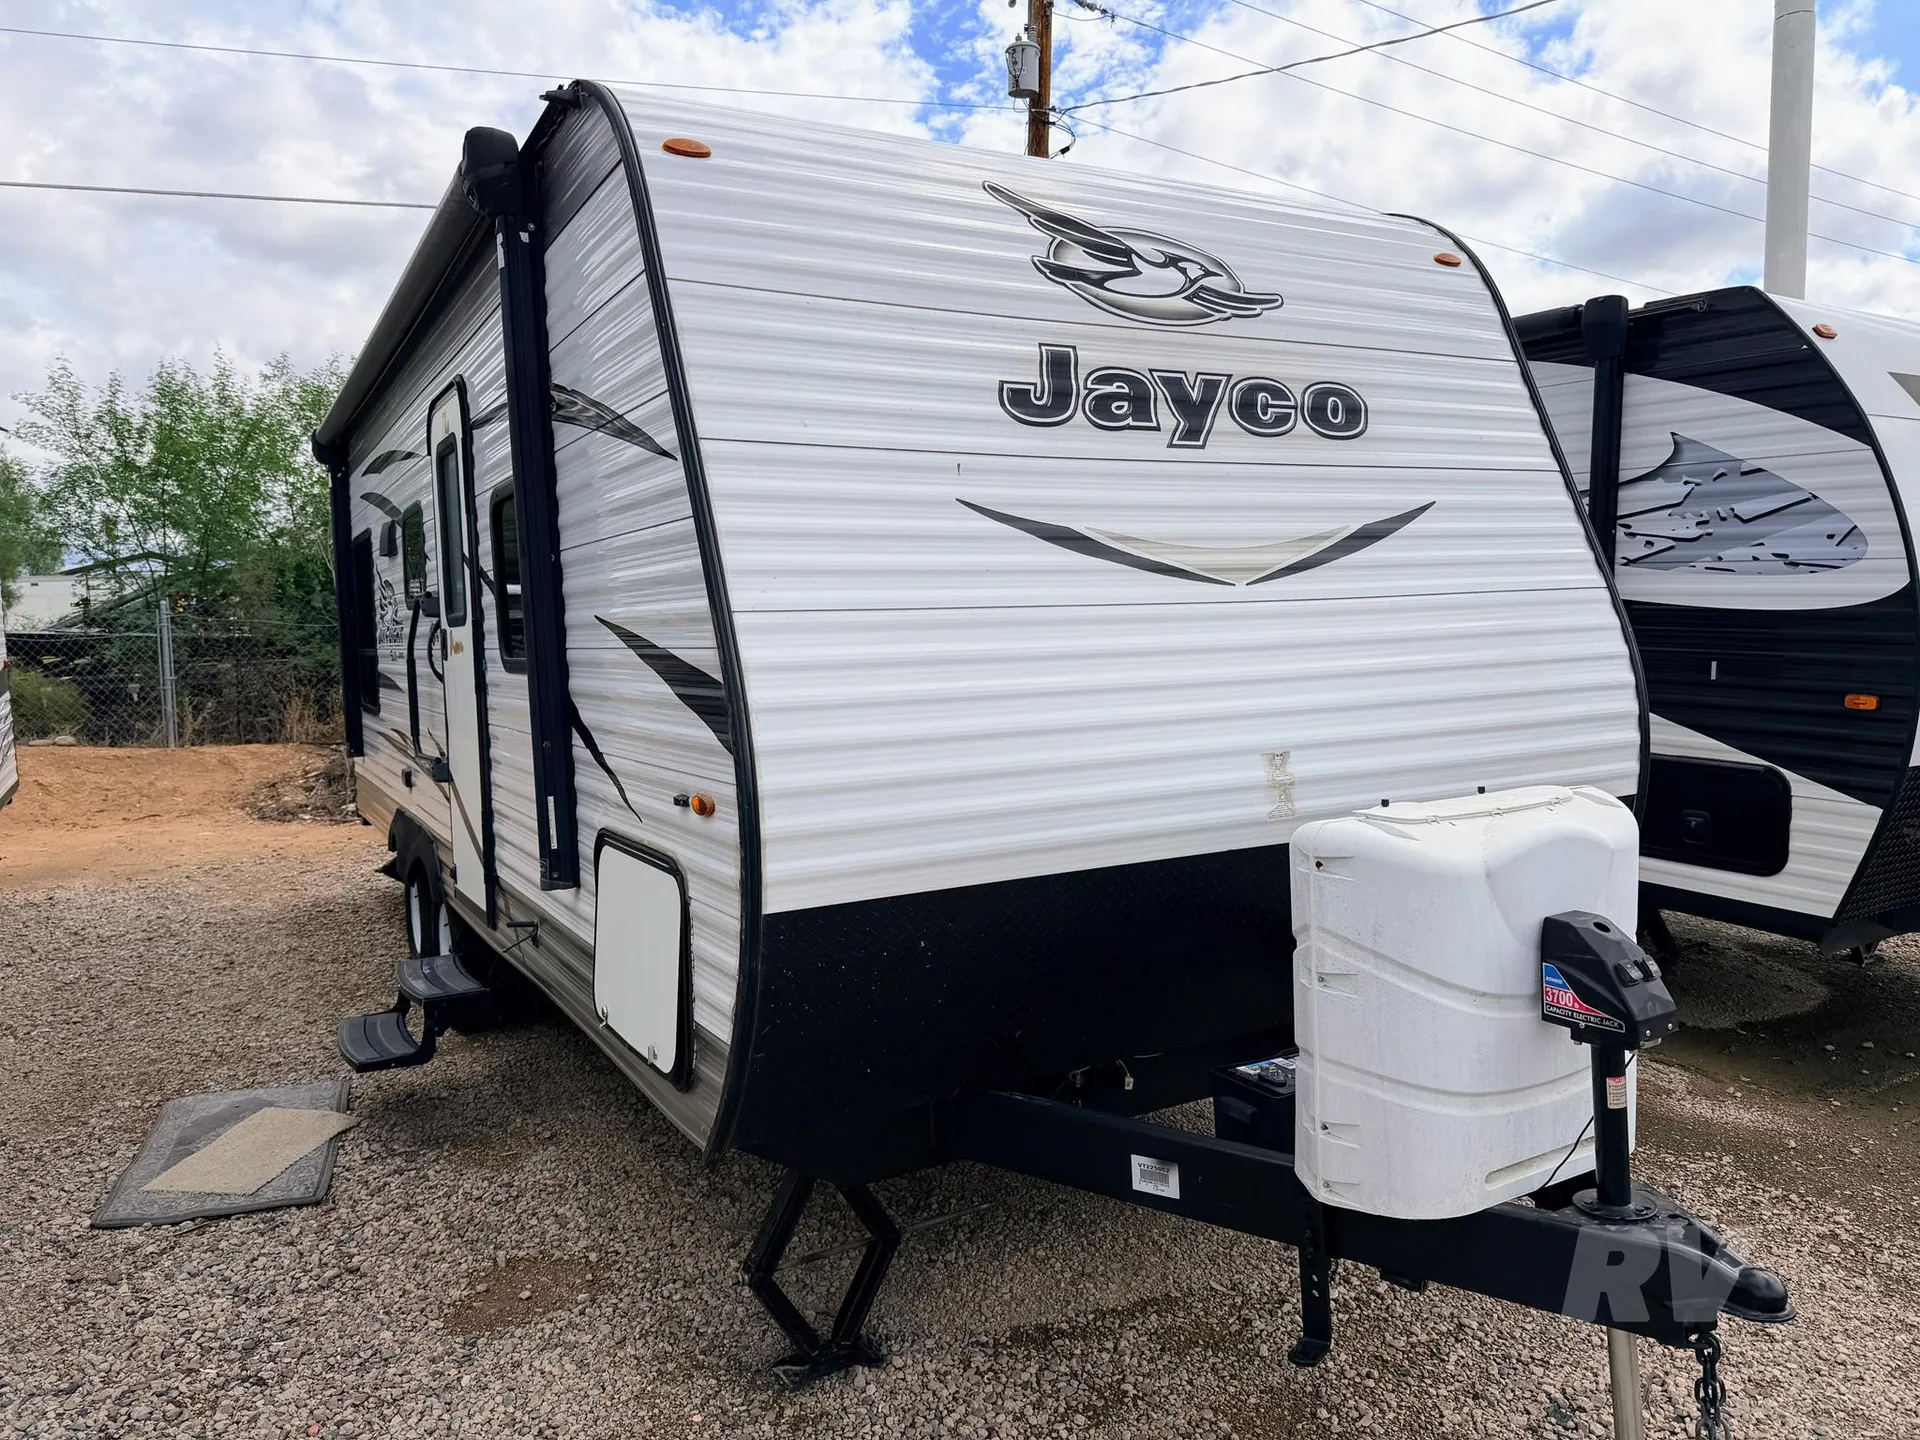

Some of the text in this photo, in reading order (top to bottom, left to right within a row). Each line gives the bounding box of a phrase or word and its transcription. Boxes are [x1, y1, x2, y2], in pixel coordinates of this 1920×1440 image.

[998, 342, 1369, 449] Jayco
[1546, 987, 1573, 1006] 3700
[1546, 1005, 1620, 1028] CAPACITY ELECTRIC JACK
